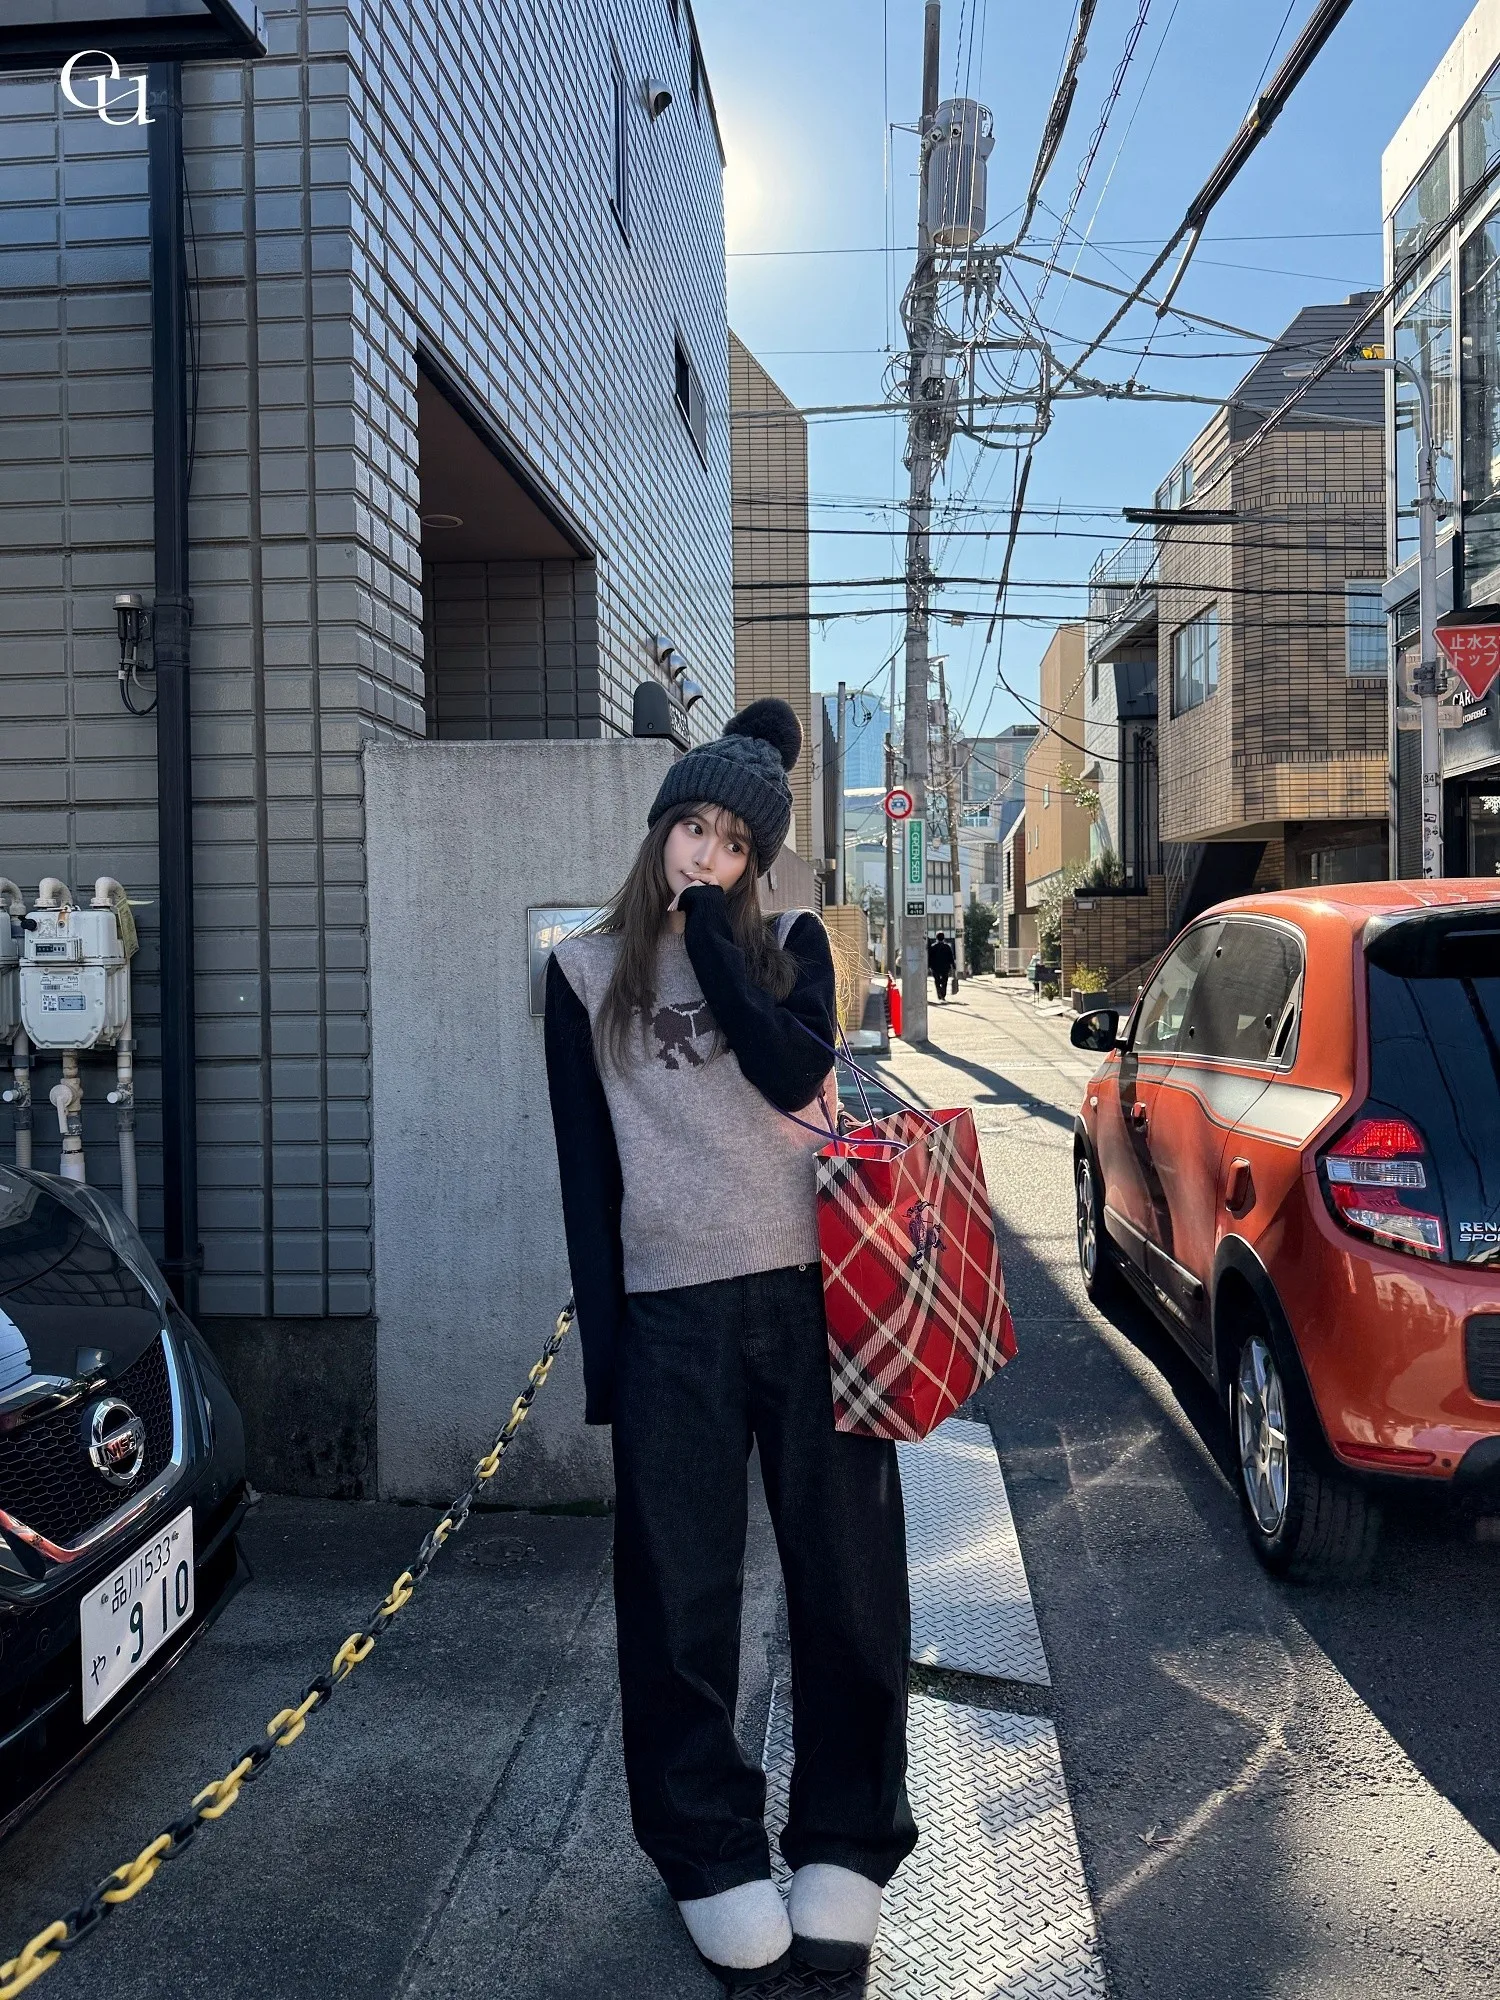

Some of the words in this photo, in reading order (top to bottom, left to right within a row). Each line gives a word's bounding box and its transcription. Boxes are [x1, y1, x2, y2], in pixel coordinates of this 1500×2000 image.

[1453, 651, 1499, 668] トップ
[1424, 774, 1435, 784] 34
[911, 832, 920, 860] GREEN
[911, 861, 920, 882] SEED
[1460, 1222, 1500, 1231] REN
[1460, 1233, 1500, 1241] SPO
